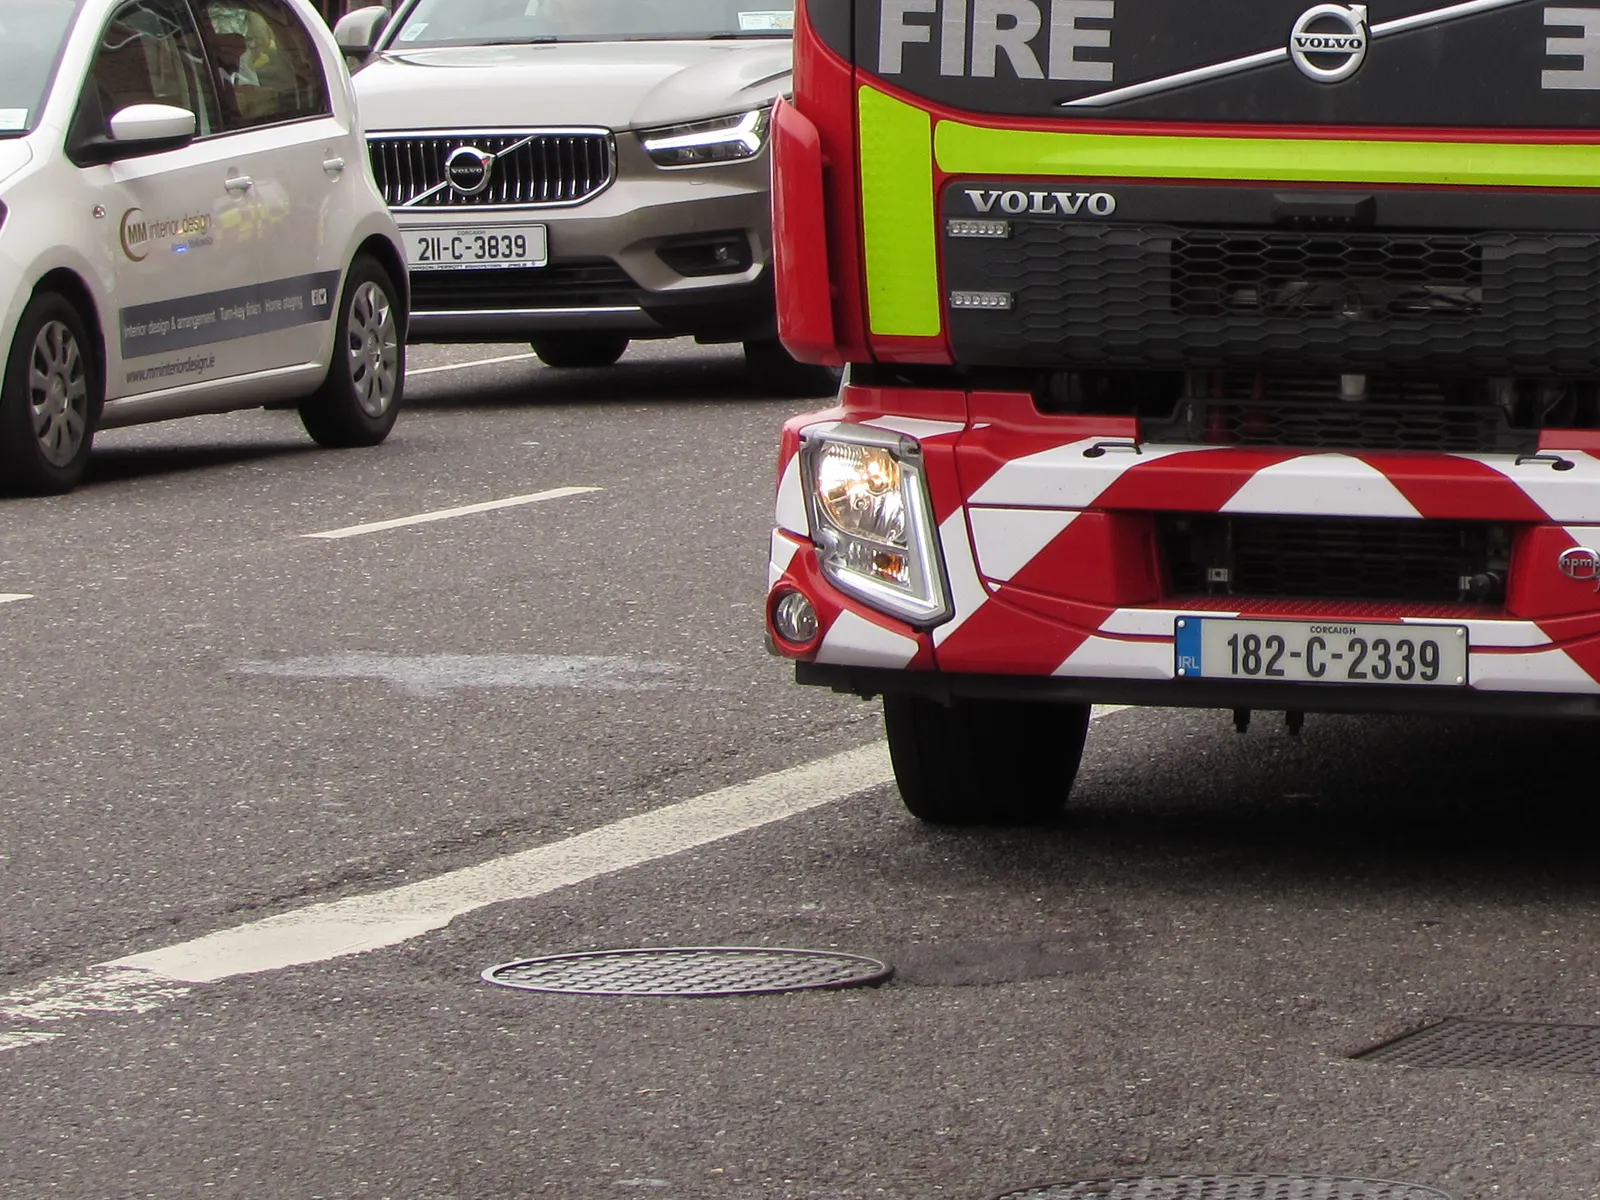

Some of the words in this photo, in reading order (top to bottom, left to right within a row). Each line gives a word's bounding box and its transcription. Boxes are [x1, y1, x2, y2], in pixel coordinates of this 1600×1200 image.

[1294, 36, 1363, 50] VOLVO
[964, 188, 1117, 216] VOLVO
[127, 221, 149, 245] MM
[181, 208, 212, 236] design
[417, 234, 527, 261] 211-C-3839
[1309, 625, 1357, 635] CORCAIGH
[1178, 655, 1200, 670] IRL
[1226, 632, 1441, 682] 182-C-2339
